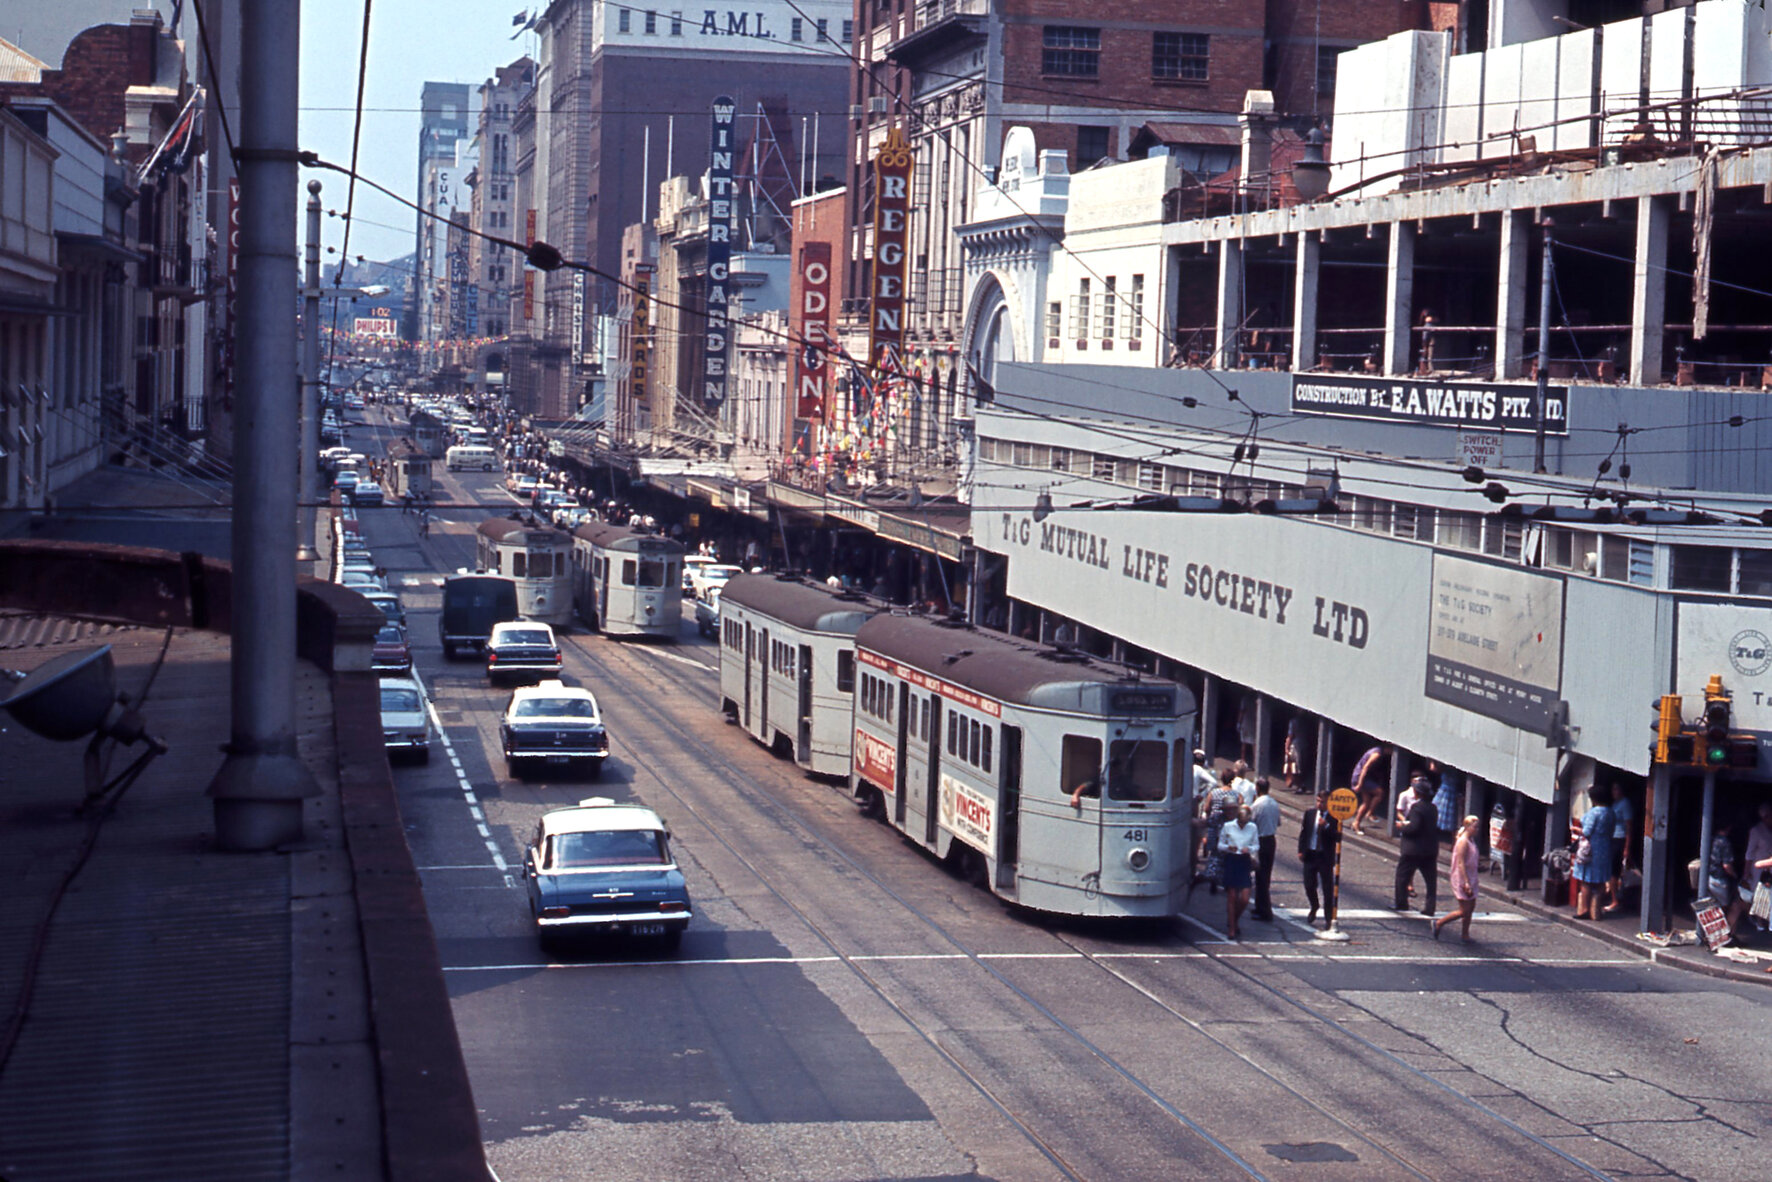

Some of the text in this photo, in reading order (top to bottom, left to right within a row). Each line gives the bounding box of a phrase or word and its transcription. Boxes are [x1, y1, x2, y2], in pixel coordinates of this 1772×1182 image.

[700, 10, 776, 38] A.M.L.
[705, 104, 734, 399] WINTER GARDEN
[357, 320, 388, 333] PHILIPS
[573, 274, 582, 363] CHRISTIES
[802, 263, 827, 397] ODEON
[634, 281, 648, 396] BAYARDS
[1295, 383, 1366, 406] CONSTRUCTION
[1501, 397, 1531, 418] PTY.
[1545, 399, 1564, 420] TD.
[1463, 446, 1496, 455] POWER
[1464, 435, 1498, 445] SWITCH
[1471, 456, 1488, 464] OFF
[1040, 521, 1109, 570] MUTUAL
[1123, 545, 1169, 589] LIFE
[1184, 563, 1293, 625] SOCIETY
[1313, 596, 1369, 650] LTD
[956, 791, 991, 832] VINCENT'S
[1124, 829, 1148, 842] 481
